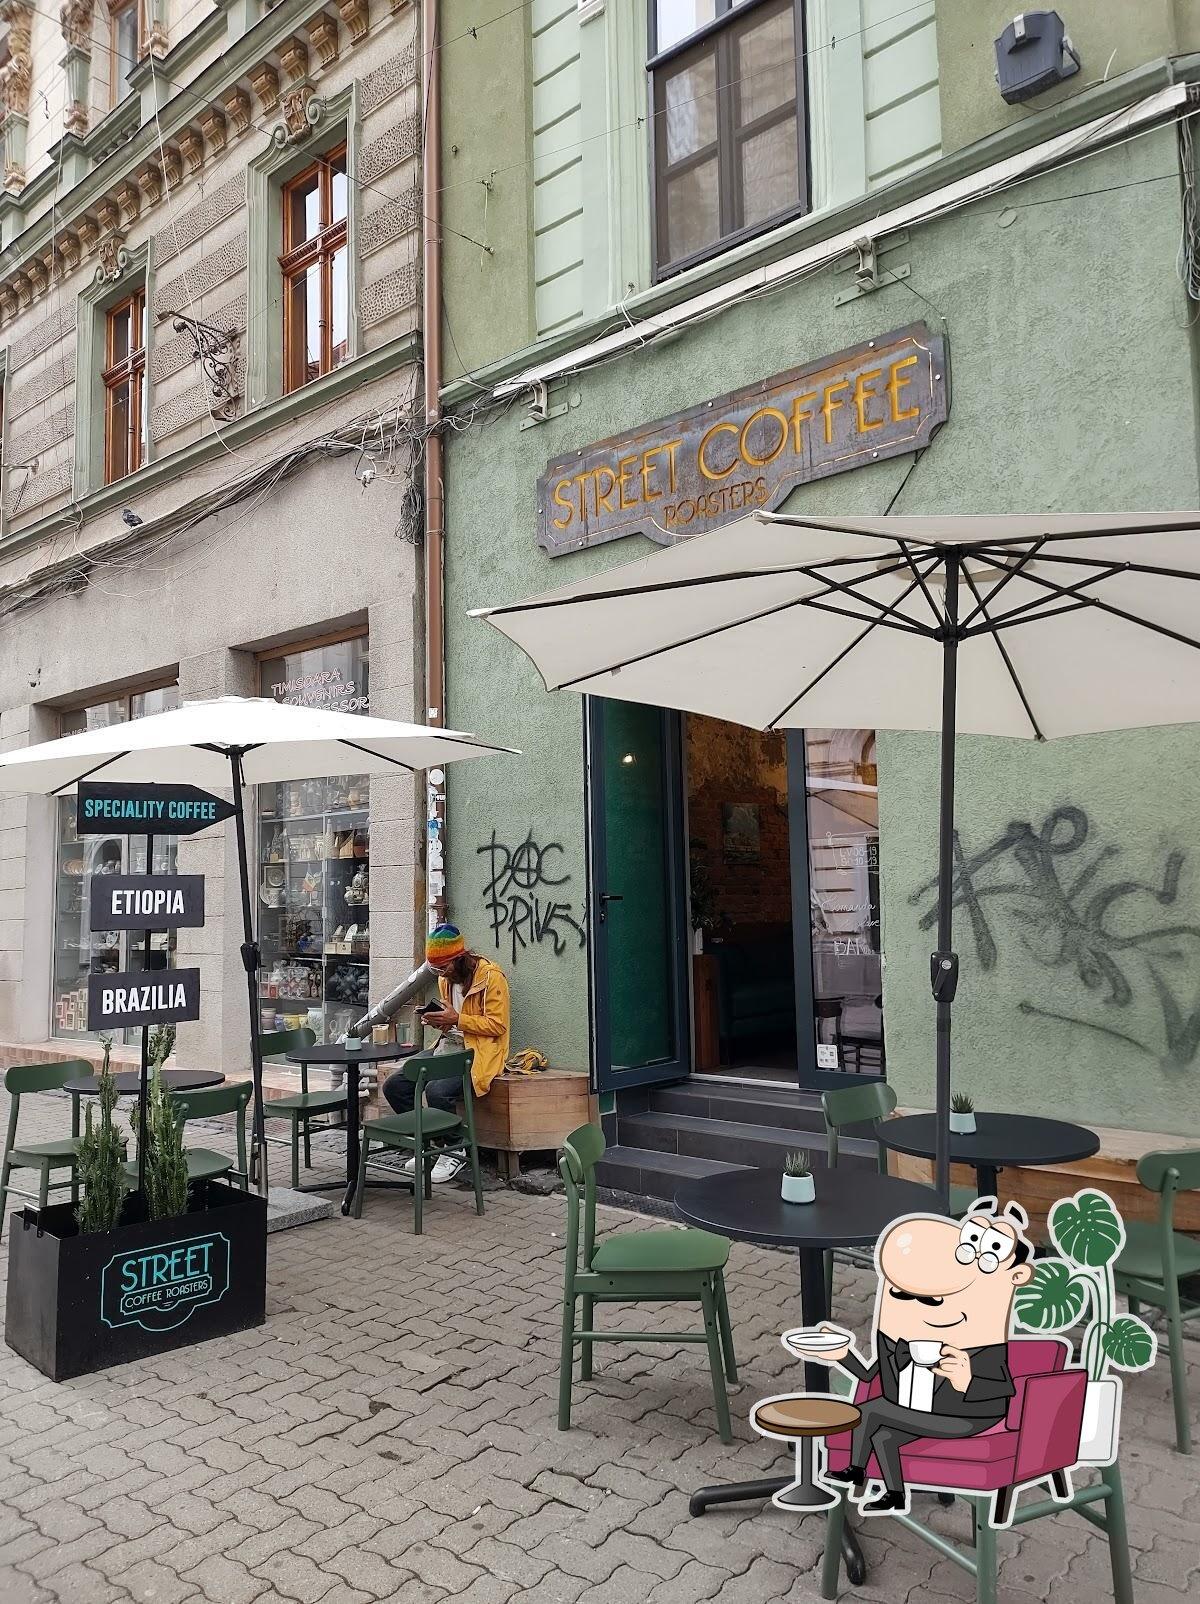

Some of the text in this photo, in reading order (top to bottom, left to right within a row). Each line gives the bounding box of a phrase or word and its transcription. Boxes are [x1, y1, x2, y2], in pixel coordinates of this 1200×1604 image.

[552, 355, 920, 530] STREET COFFEE
[663, 476, 770, 529] ROASTERS
[84, 799, 216, 820] SPECIALITY COFFEE
[111, 889, 185, 915] ETIOPIA
[101, 983, 187, 1015] BRAZILIA
[121, 1242, 214, 1292] STREET
[125, 1279, 208, 1308] COFFEE ROASTERS
